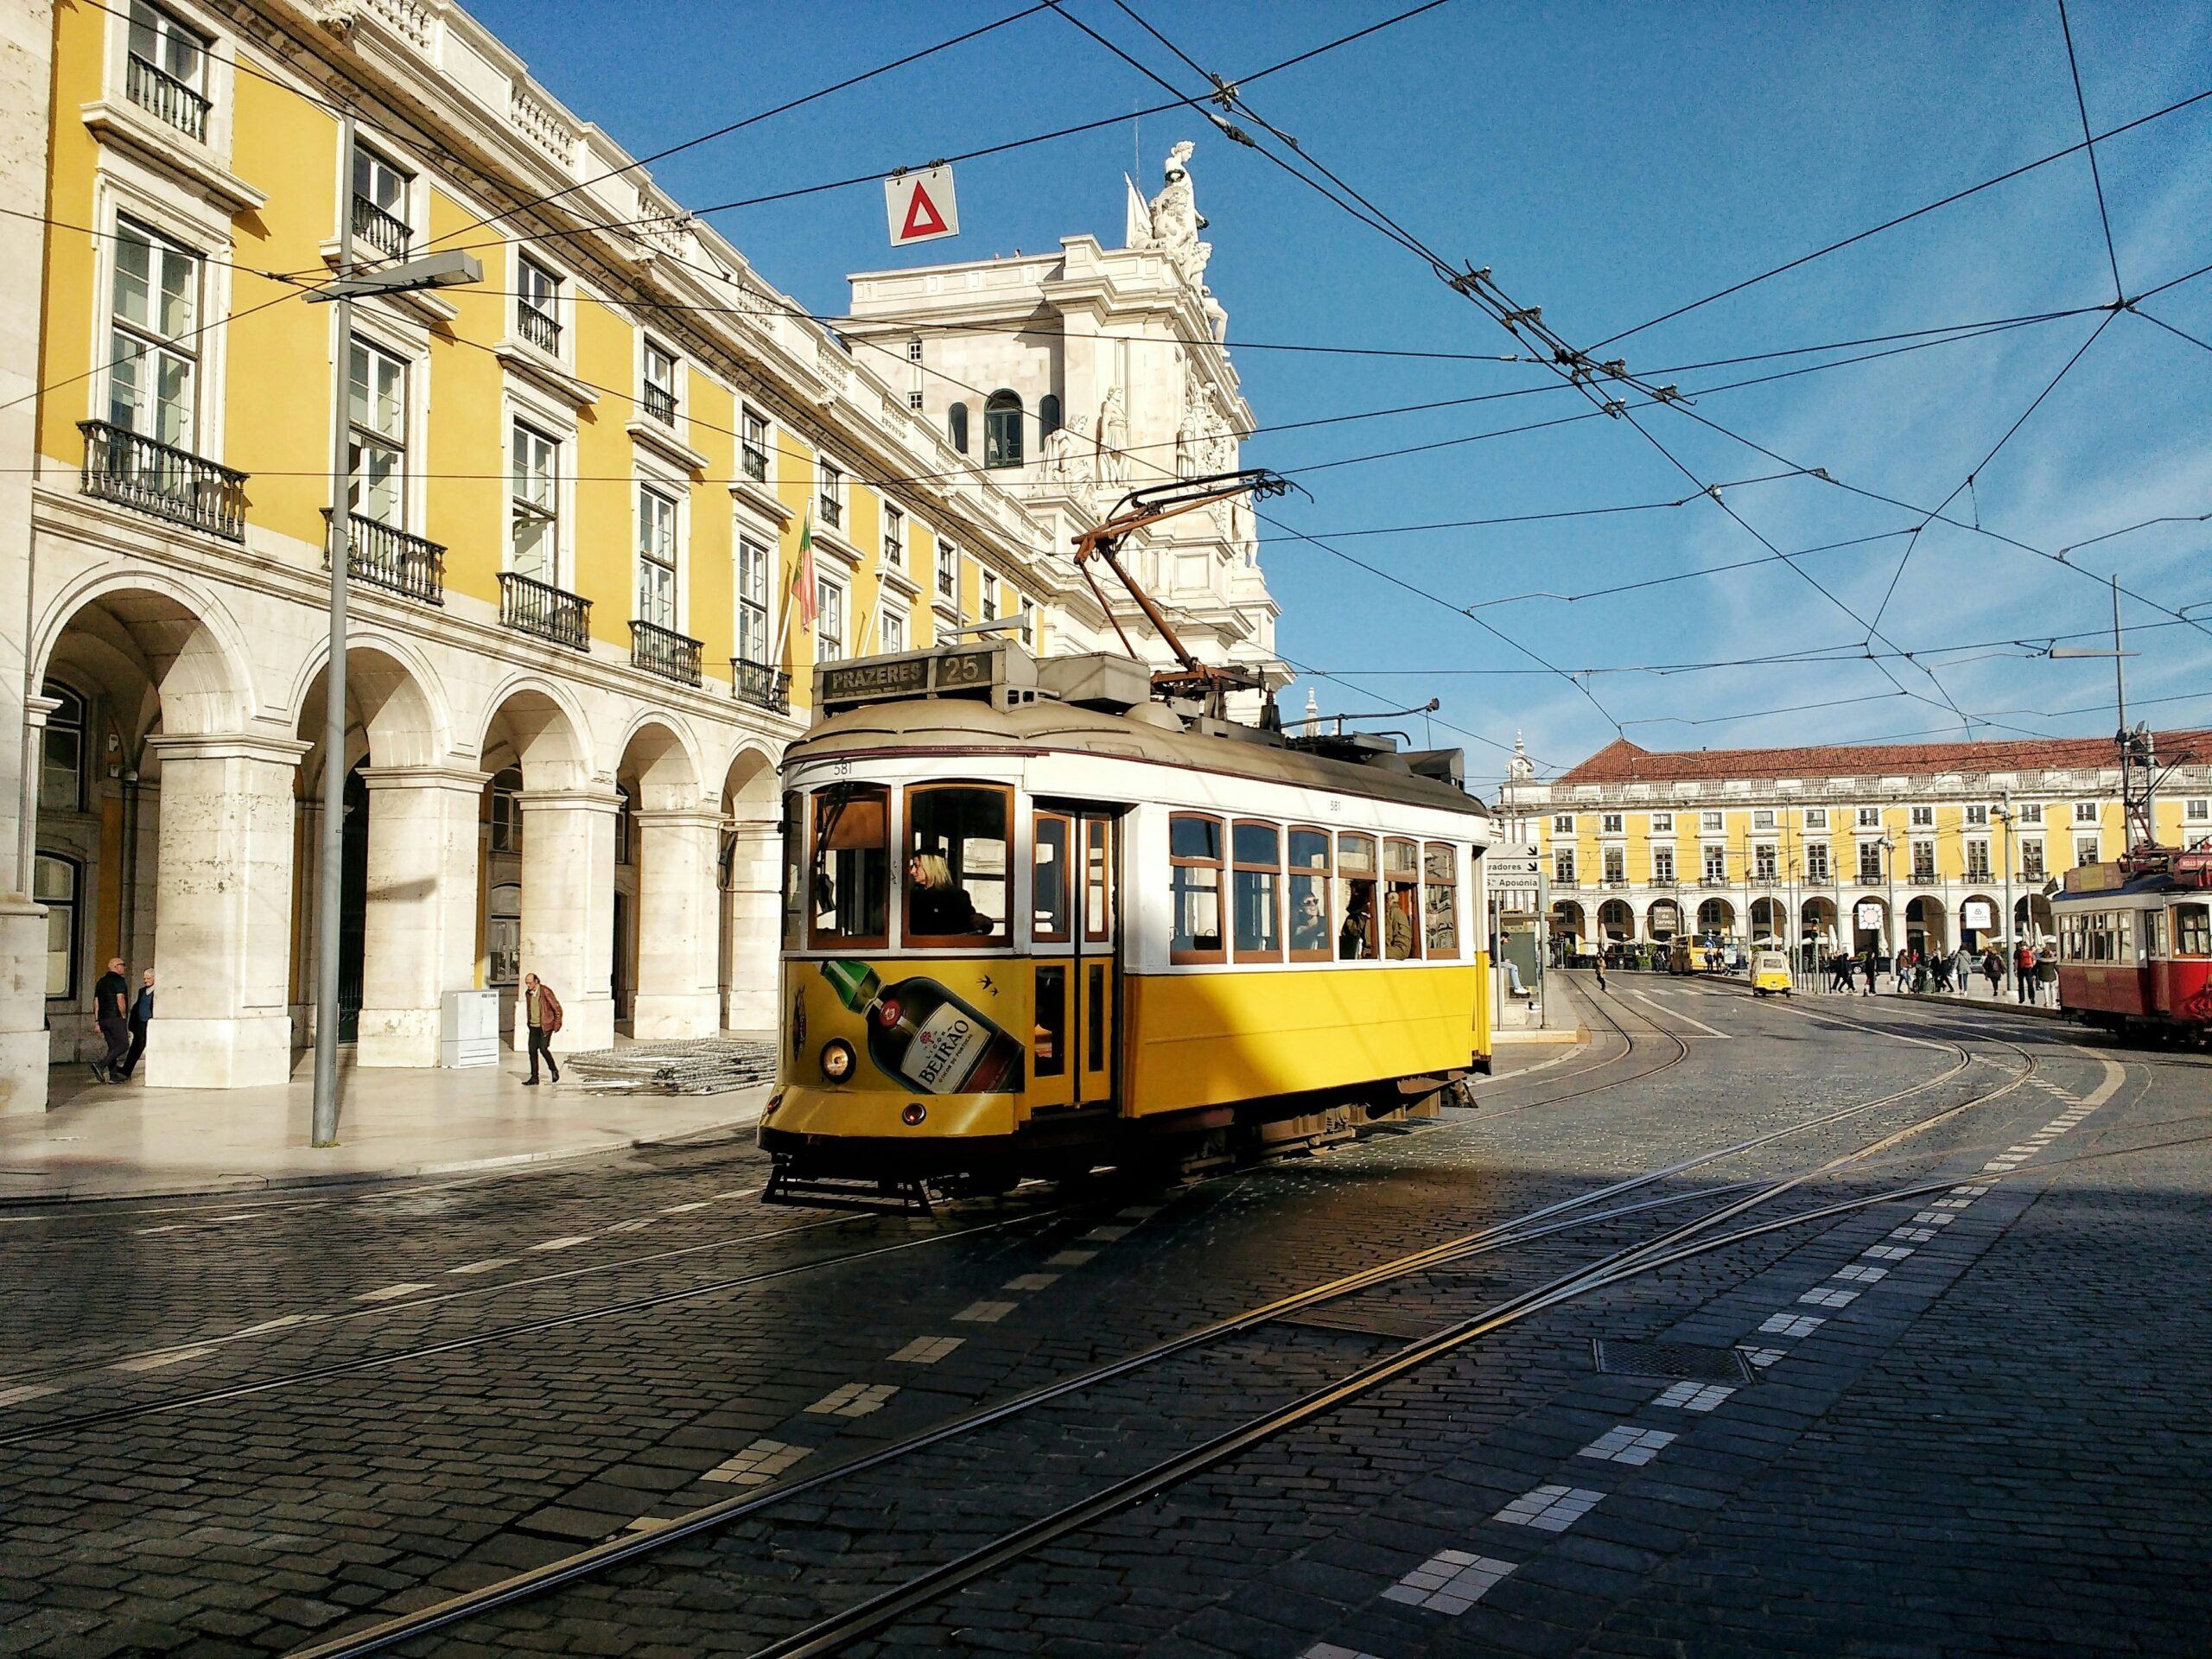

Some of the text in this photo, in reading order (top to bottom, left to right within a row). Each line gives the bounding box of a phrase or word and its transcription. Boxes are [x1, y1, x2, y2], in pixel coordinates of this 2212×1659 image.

[832, 655, 979, 689] PRAZERES 25
[834, 762, 852, 776] 581
[1330, 800, 1341, 812] 581
[1488, 862, 1522, 871] radores
[1499, 878, 1537, 887] Apolónia
[918, 1019, 969, 1085] BEIRÃO
[925, 1031, 946, 1059] LICOR
